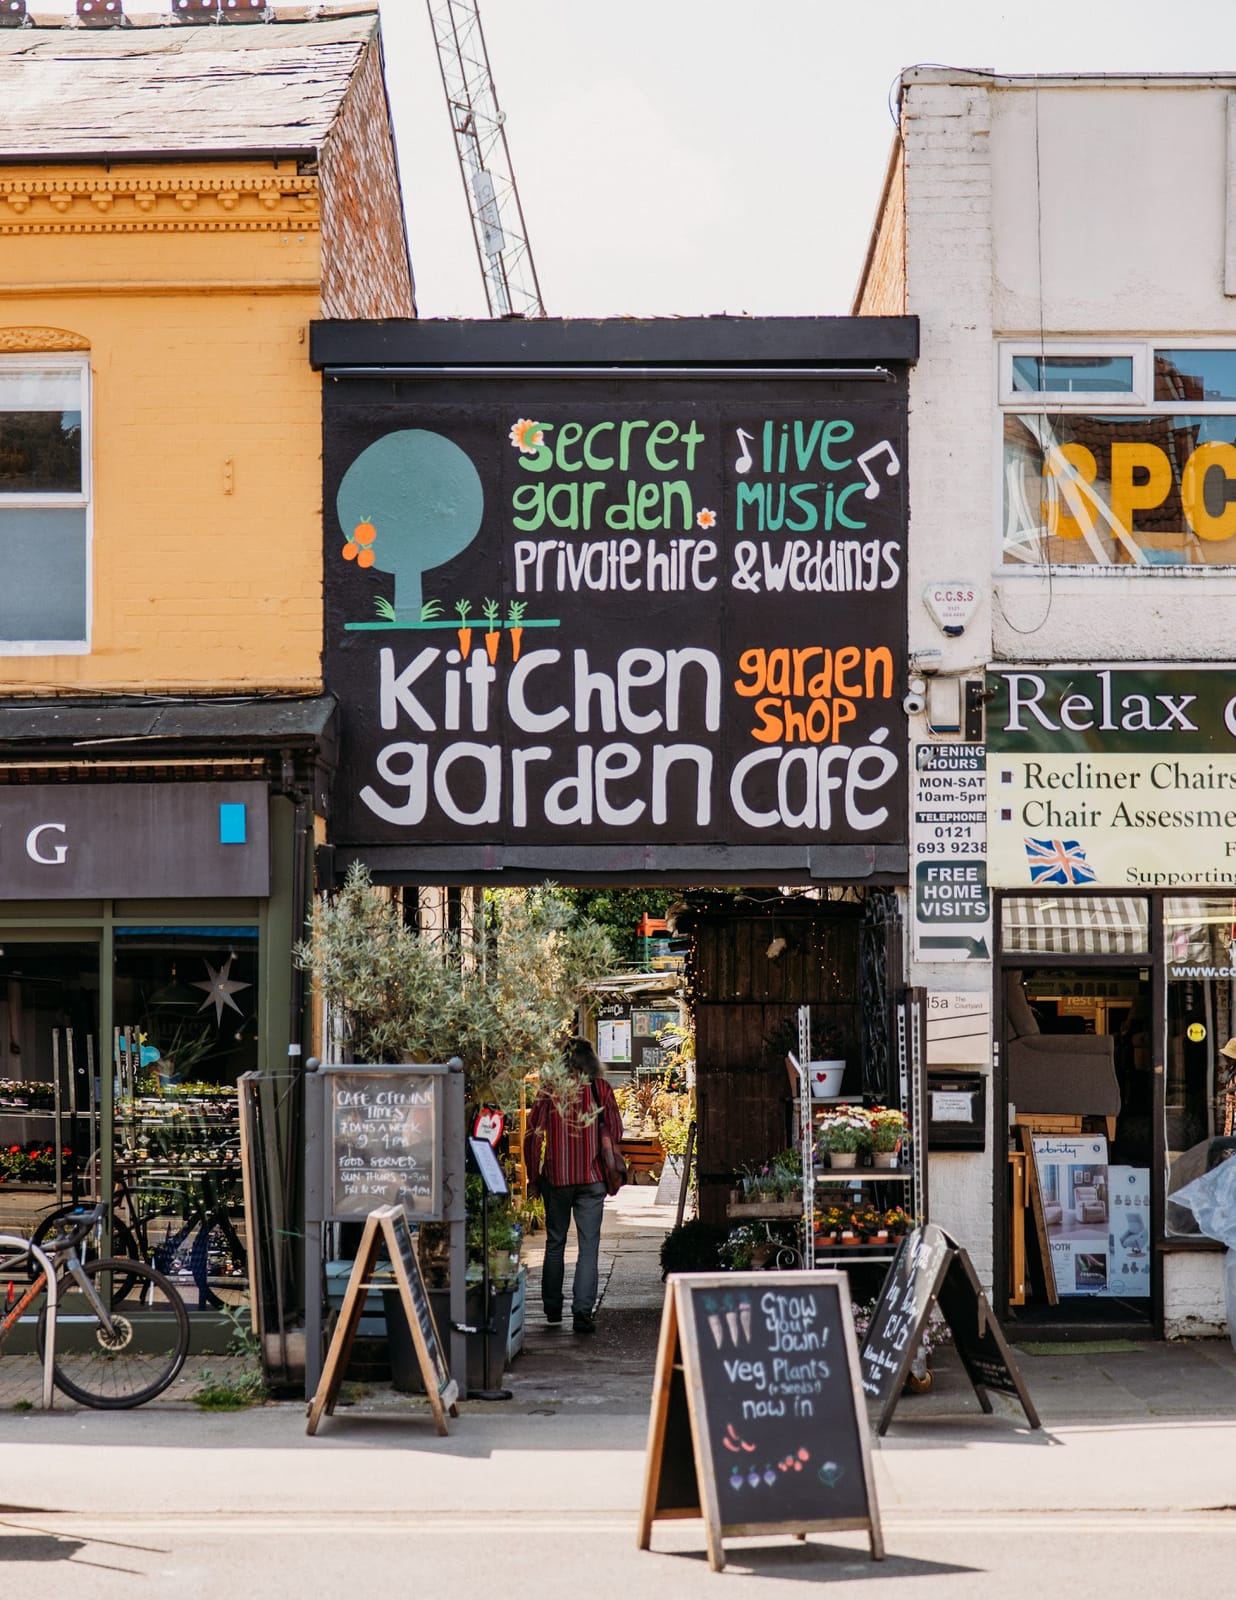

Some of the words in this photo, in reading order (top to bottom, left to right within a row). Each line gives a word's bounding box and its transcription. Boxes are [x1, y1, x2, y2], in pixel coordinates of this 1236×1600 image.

[518, 420, 704, 472] secret
[762, 419, 854, 472] live
[512, 479, 693, 531] garden
[514, 538, 641, 593] private
[646, 538, 718, 592] hire
[734, 645, 893, 699] garden
[1001, 670, 1199, 732] Relax
[927, 759, 978, 769] HOURS
[1023, 762, 1141, 790] Recliner
[1150, 762, 1236, 790] Chairs
[359, 741, 713, 828] garden
[730, 726, 899, 830] café
[919, 777, 985, 788] MON-SAT
[1022, 800, 1102, 828] Chair
[1110, 801, 1236, 828] Assessme
[935, 827, 972, 838] 0121
[916, 842, 945, 854] 693
[951, 842, 987, 854] 9238
[927, 868, 977, 881] FREE
[1126, 867, 1236, 887] Supportin
[924, 885, 982, 899] HOME
[921, 903, 986, 916] VISITS
[339, 1155, 365, 1168] FOOD
[370, 1156, 417, 1168] SERVED
[723, 1359, 766, 1391] Veg
[742, 1399, 785, 1419] now
[794, 1394, 814, 1417] in
